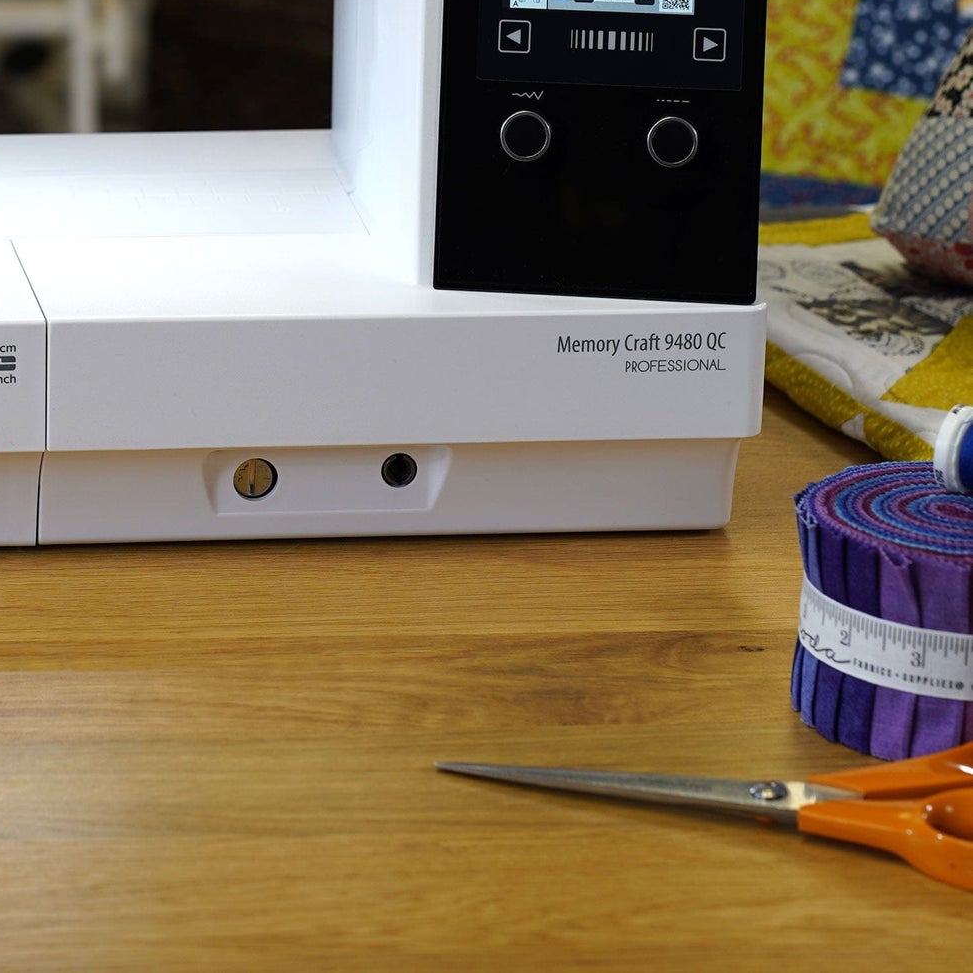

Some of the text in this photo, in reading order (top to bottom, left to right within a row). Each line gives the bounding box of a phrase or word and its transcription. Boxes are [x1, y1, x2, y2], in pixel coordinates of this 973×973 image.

[0, 344, 17, 353] cm
[557, 331, 727, 356] Memory Craft 9480 QC
[625, 359, 726, 373] PROFESSIONAL
[840, 629, 848, 646] 2
[910, 652, 921, 668] 3
[853, 657, 892, 678] FABRICS
